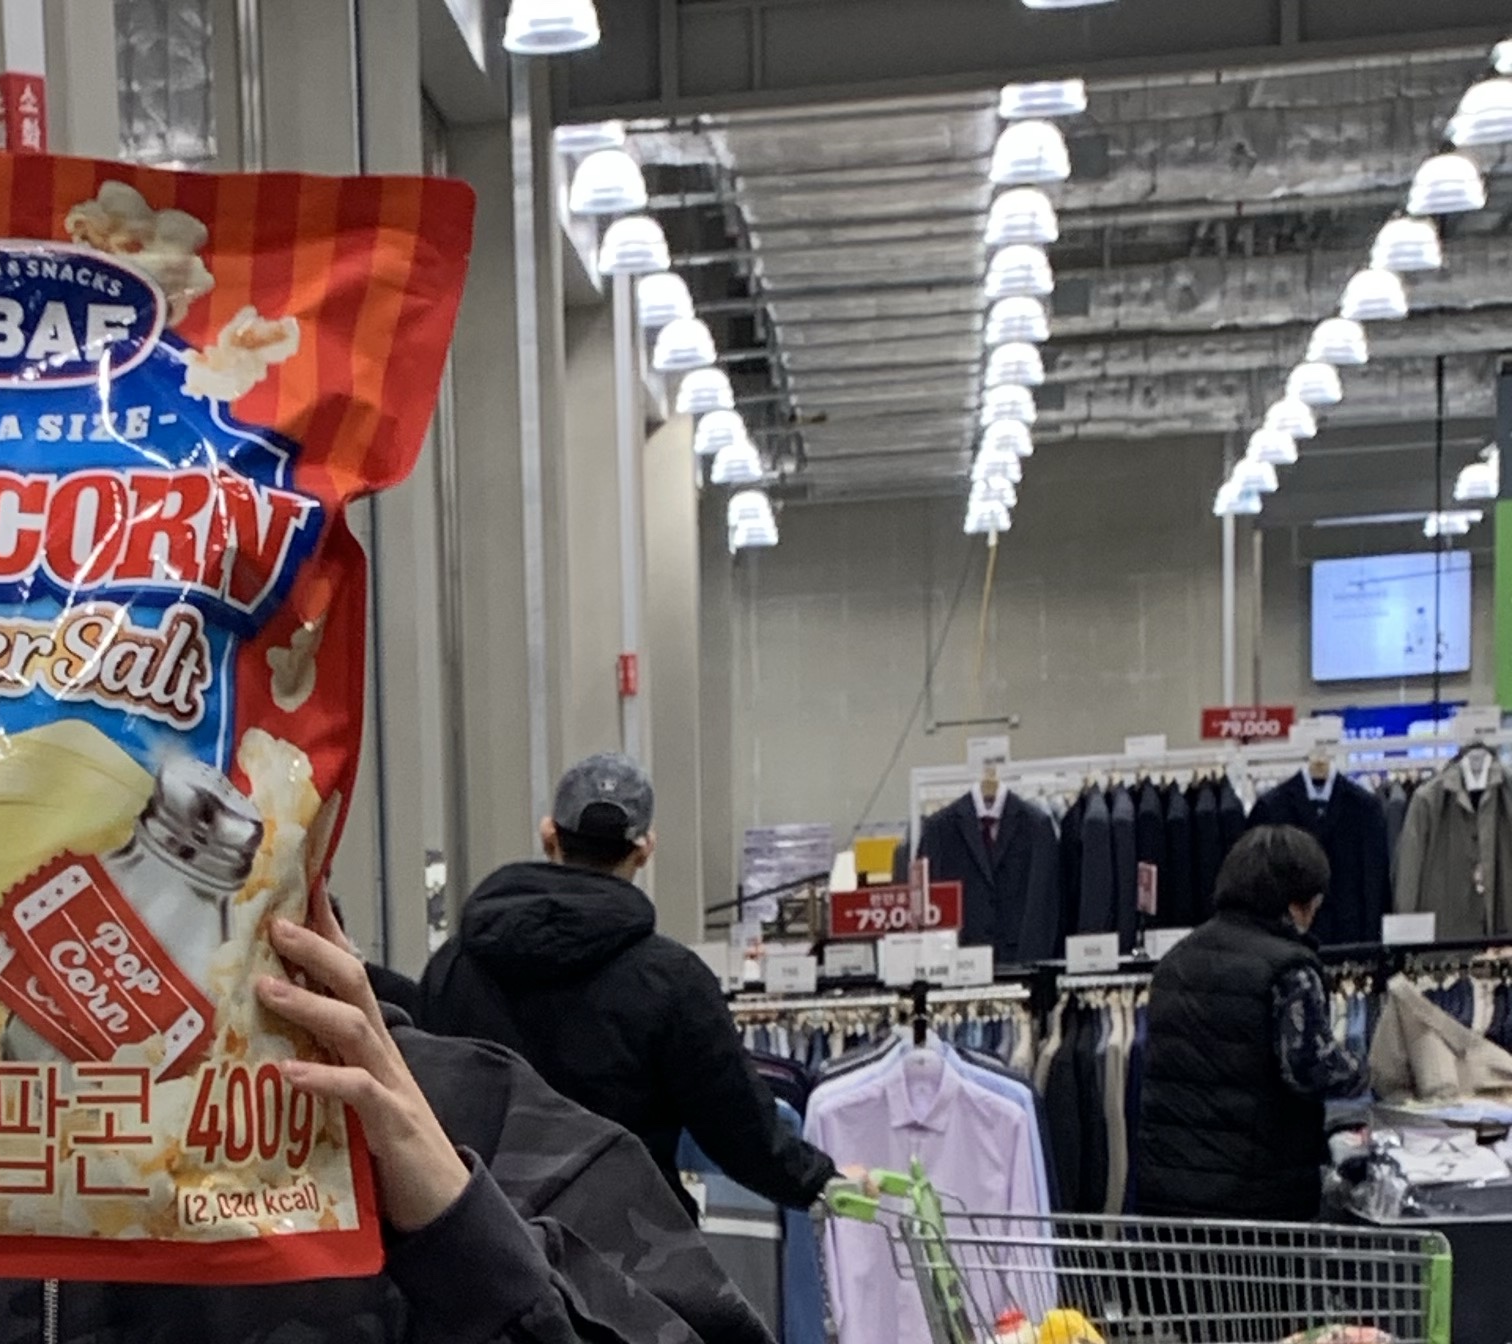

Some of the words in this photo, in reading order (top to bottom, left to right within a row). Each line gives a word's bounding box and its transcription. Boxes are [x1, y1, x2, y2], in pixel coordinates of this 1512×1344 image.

[26, 260, 123, 297] SNACKS
[35, 405, 151, 443] SIZE
[854, 903, 941, 931] 79,00
[90, 921, 161, 996] Pop
[49, 940, 130, 1034] Corn
[186, 1063, 315, 1170] 400g
